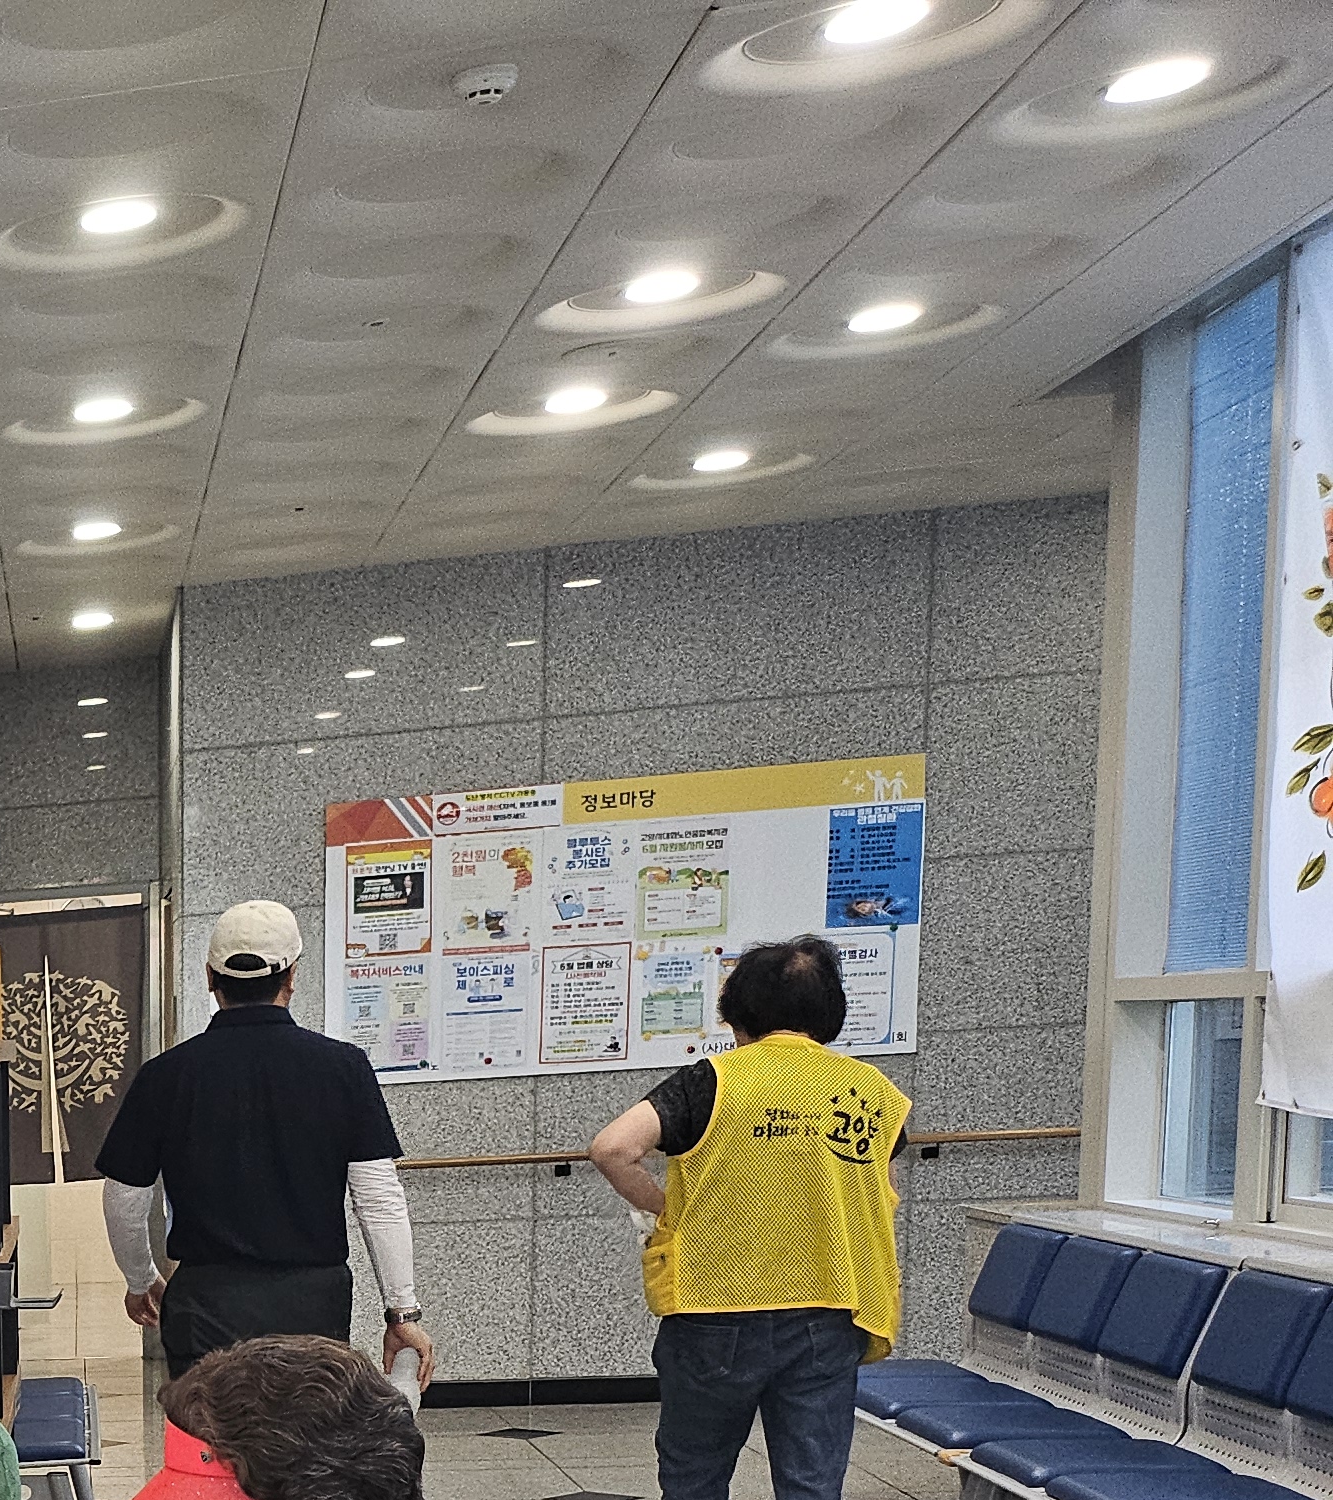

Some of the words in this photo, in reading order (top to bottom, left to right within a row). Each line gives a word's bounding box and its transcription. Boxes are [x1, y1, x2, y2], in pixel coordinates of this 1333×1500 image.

[493, 789, 516, 800] CCTV
[580, 787, 657, 813] 정보마당
[566, 836, 612, 849] 블루투스
[642, 843, 658, 854] 6월
[659, 841, 704, 853] 자원봉사자
[705, 839, 724, 850] 모집
[571, 847, 606, 859] 봉사단
[397, 863, 409, 872] TV
[565, 857, 611, 871] 추가모집
[349, 963, 425, 980] 복지서비스안내
[455, 963, 515, 978] 보이스피싱
[559, 962, 574, 971] 6월
[596, 959, 614, 969] 상담
[503, 976, 515, 988] 로
